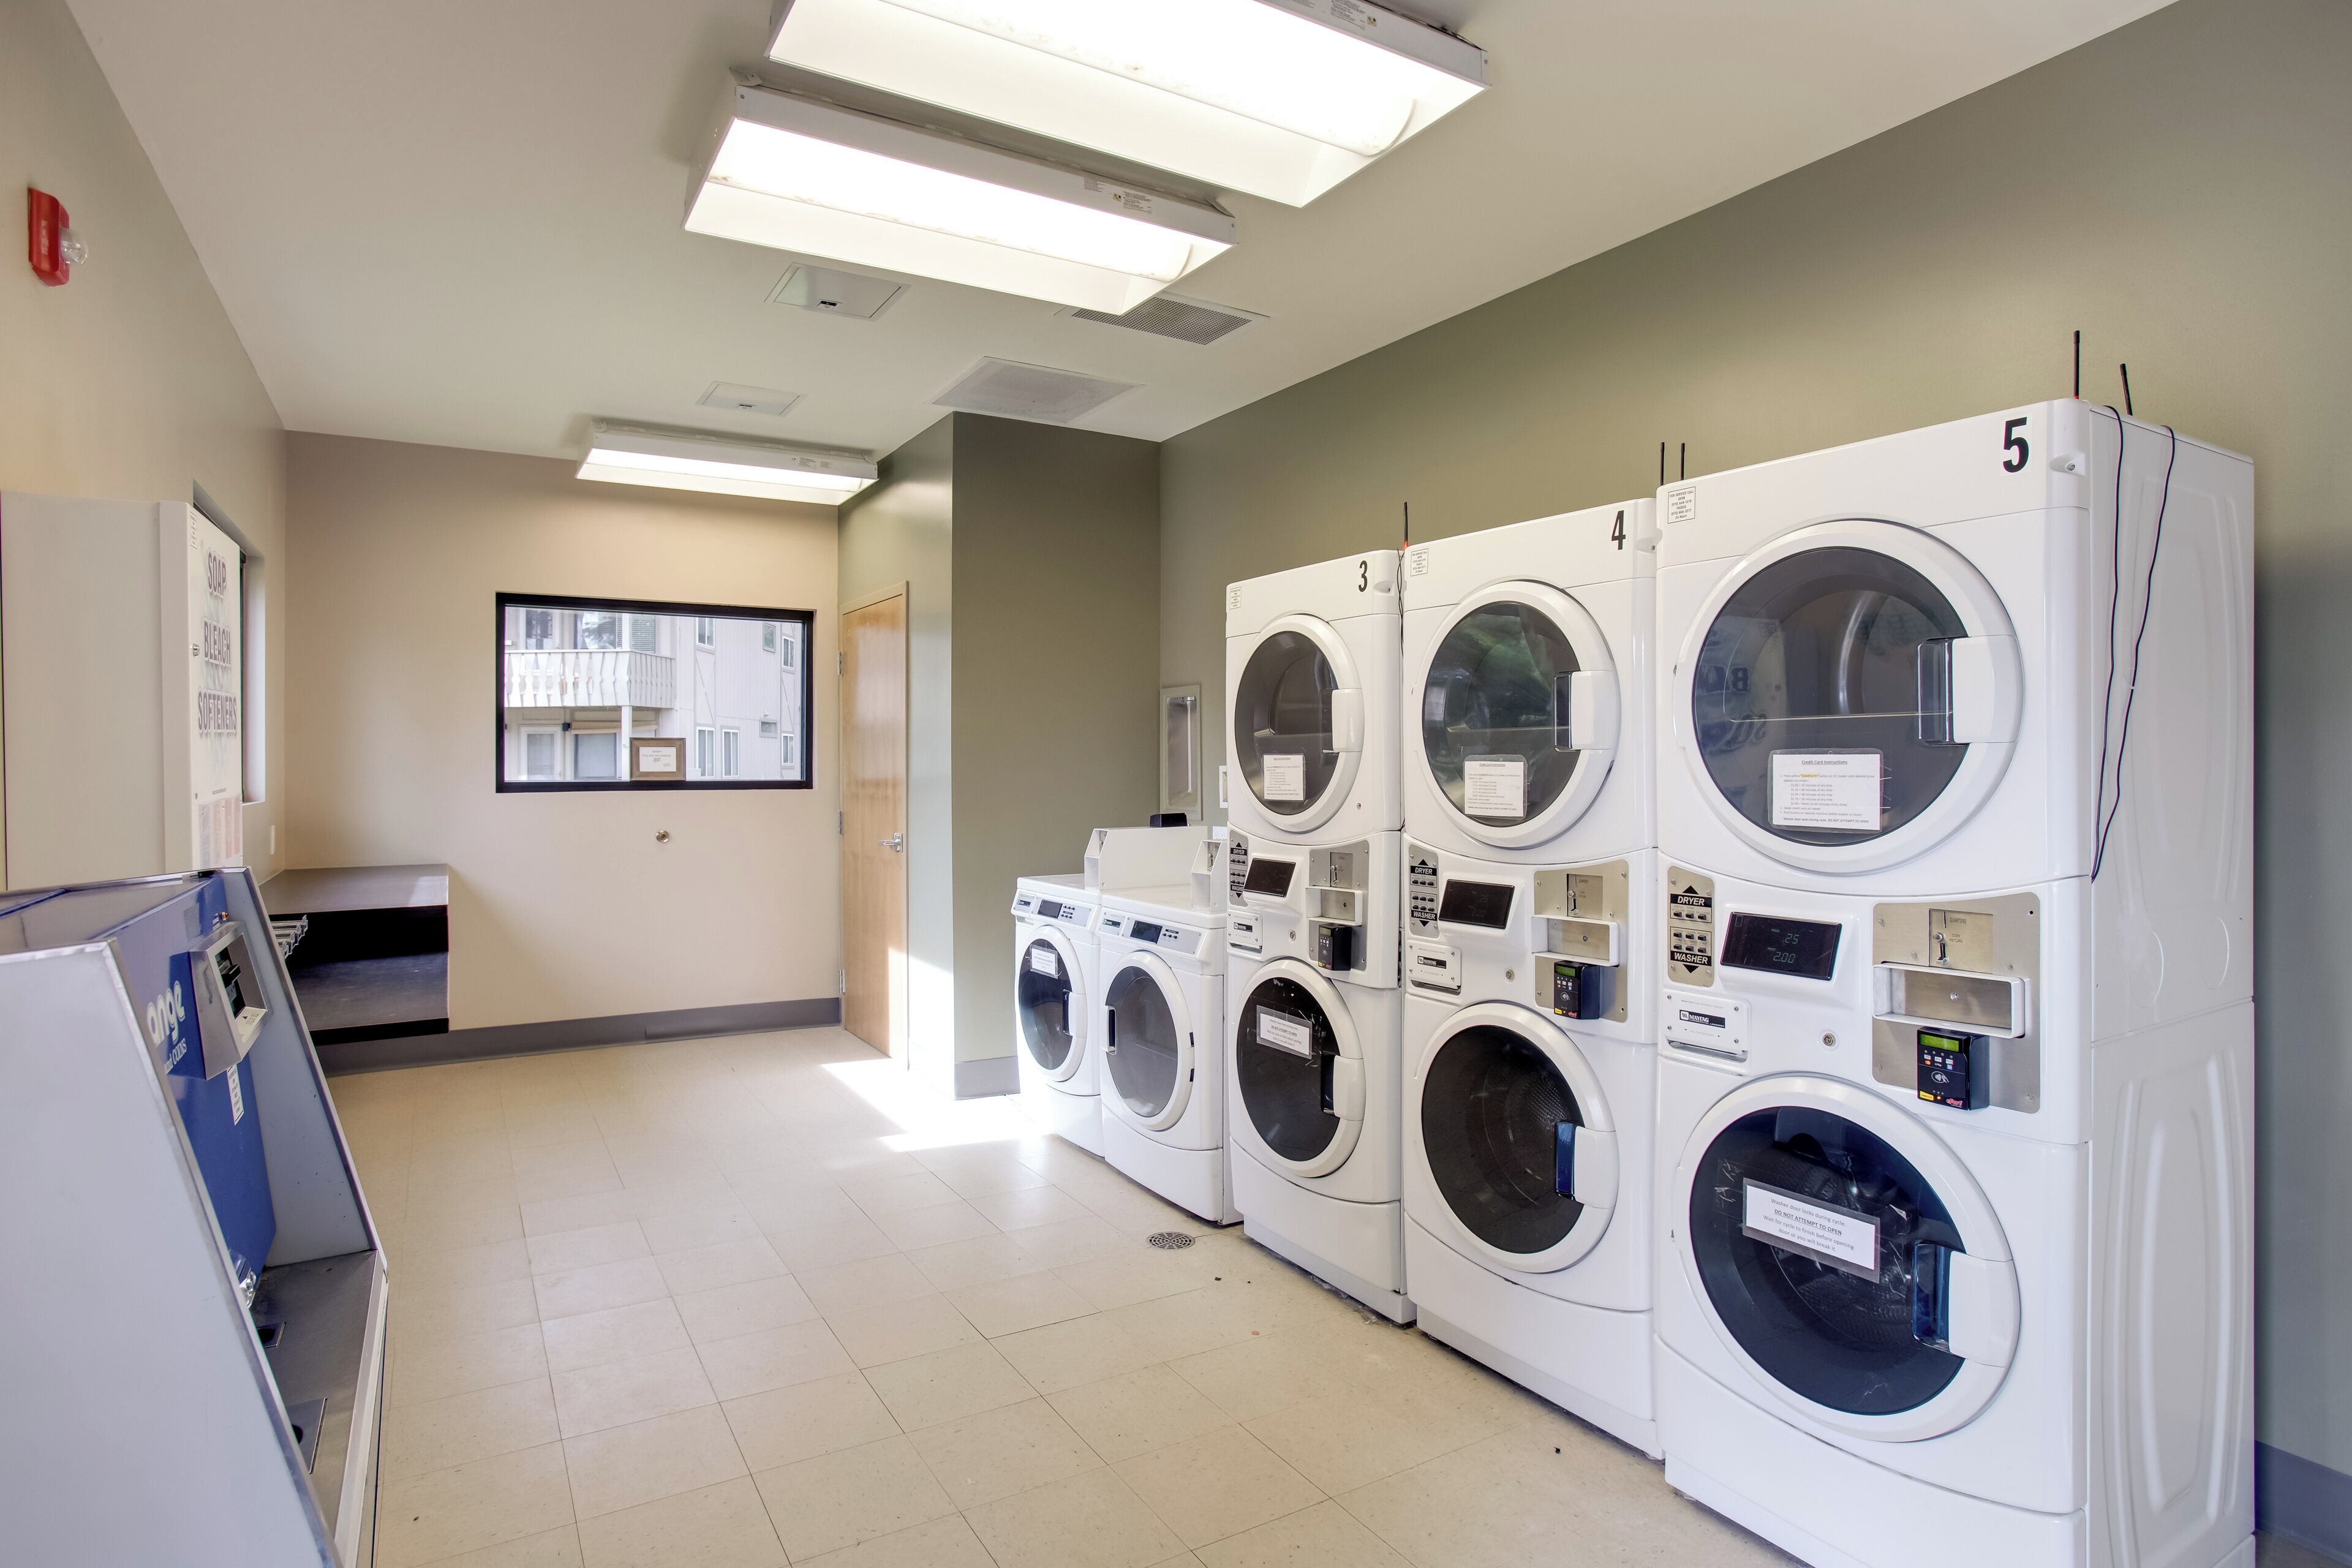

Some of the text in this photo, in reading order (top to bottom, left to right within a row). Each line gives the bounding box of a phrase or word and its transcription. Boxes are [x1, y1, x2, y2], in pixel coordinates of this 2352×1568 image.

[2003, 417, 2029, 472] 5
[1611, 510, 1626, 550] 4
[208, 551, 227, 597] SOAP
[1359, 560, 1367, 592] 3
[204, 620, 232, 668] BLEACH
[198, 690, 238, 733] SOFTENERS
[1678, 896, 1705, 906] DRYER
[1413, 911, 1435, 919] WASHER
[1782, 933, 1800, 944] .25
[1674, 952, 1708, 964] WASHER
[1773, 952, 1796, 963] 2.00
[147, 981, 186, 1047] ange
[172, 1038, 187, 1065] COINS
[1771, 1199, 1789, 1208] Washer
[1802, 1208, 1814, 1216] locks
[1815, 1213, 1831, 1223] during
[1832, 1218, 1846, 1227] cycle.
[1795, 1216, 1818, 1227] ATTEMPT
[1802, 1227, 1815, 1237] finish
[1816, 1232, 1832, 1242] before
[1834, 1239, 1854, 1250] opening
[1817, 1240, 1831, 1250] break
